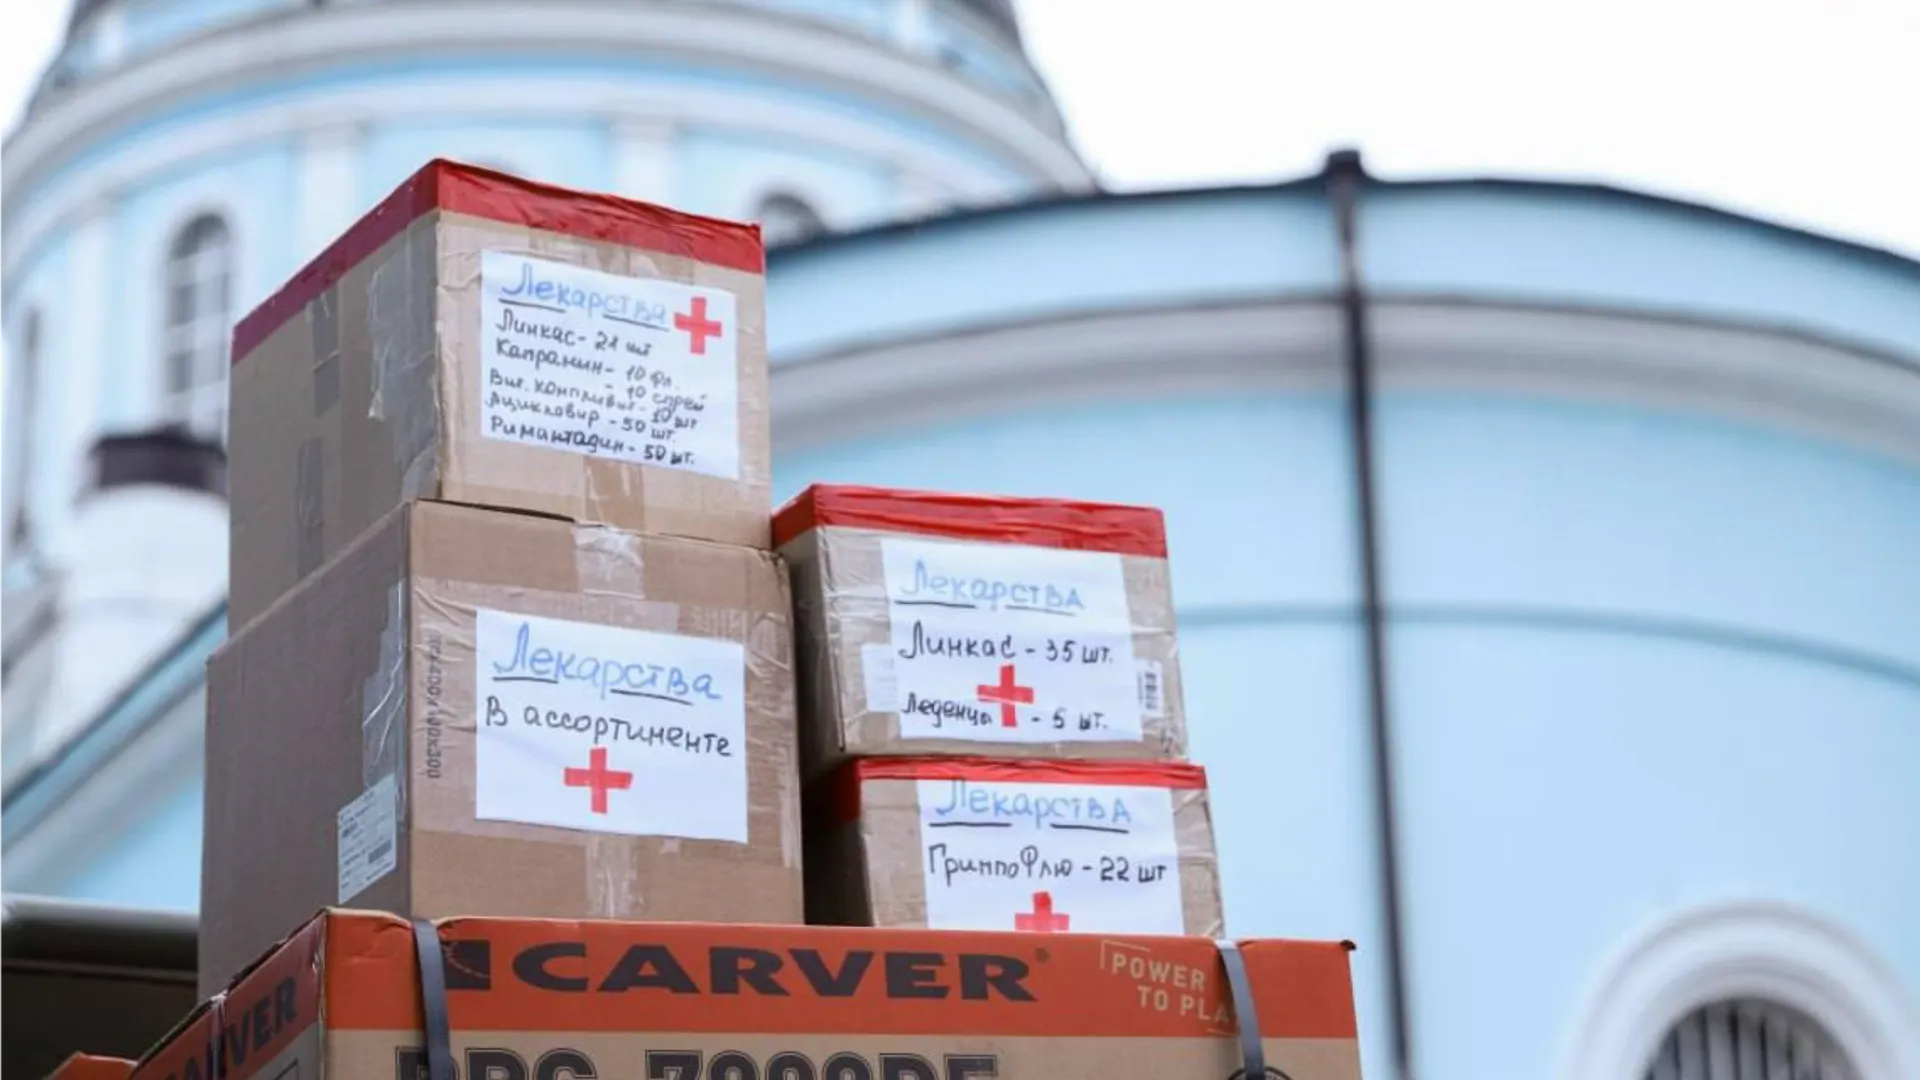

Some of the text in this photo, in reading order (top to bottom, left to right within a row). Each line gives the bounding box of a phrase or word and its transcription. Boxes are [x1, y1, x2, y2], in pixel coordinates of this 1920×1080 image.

[501, 262, 667, 322] Лекарства
[626, 364, 646, 382] 10
[644, 445, 666, 460] 50
[898, 620, 1017, 659] Линкас
[1046, 639, 1078, 662] 35
[492, 622, 722, 700] Лекарства
[486, 696, 508, 727] В
[1052, 708, 1066, 729] 5
[1100, 856, 1130, 881] 22
[511, 942, 1039, 1002] CARVER
[1112, 952, 1205, 992] POWER
[1137, 984, 1229, 1023] TO PLA
